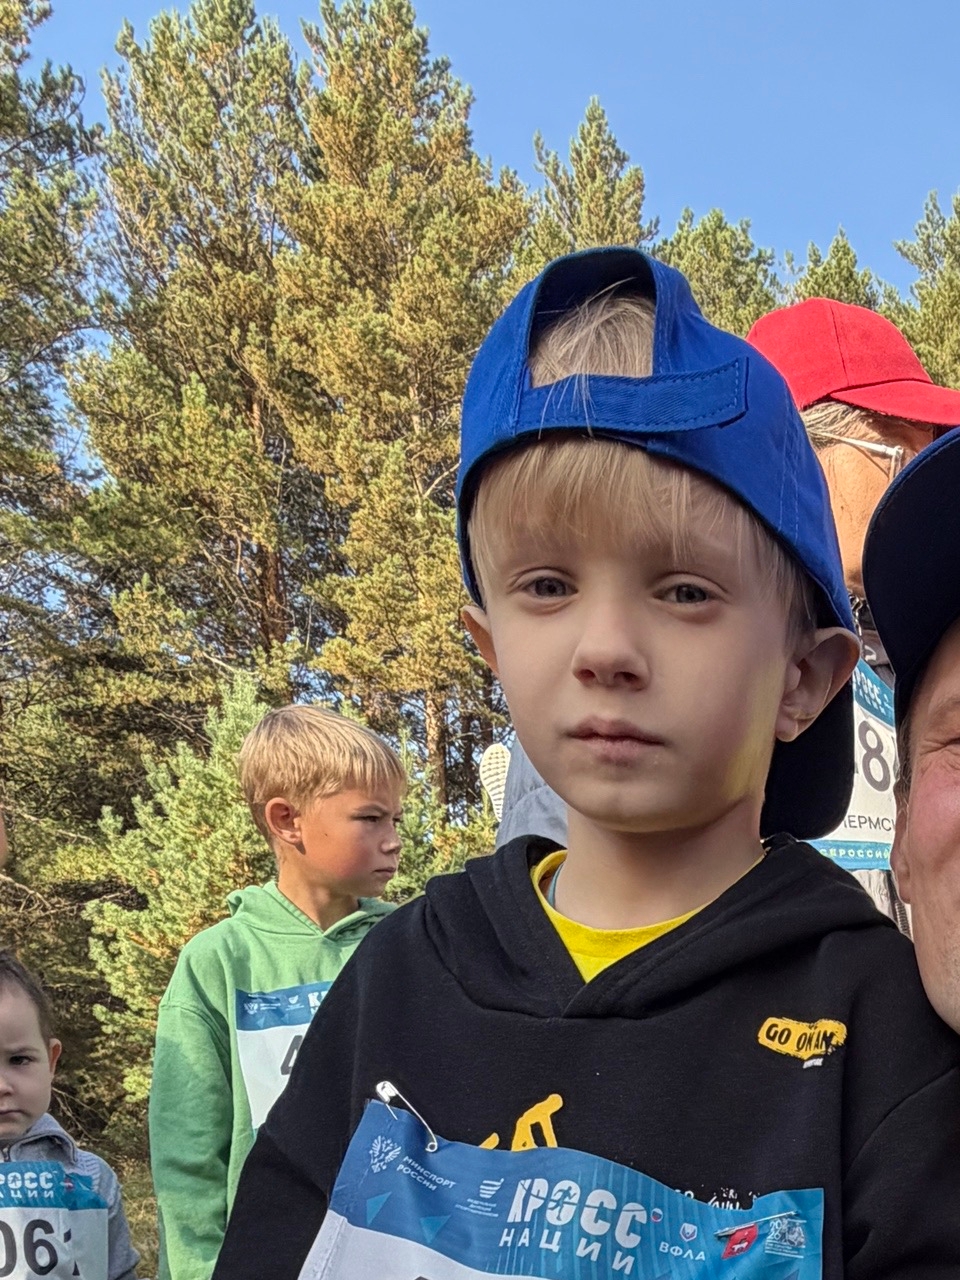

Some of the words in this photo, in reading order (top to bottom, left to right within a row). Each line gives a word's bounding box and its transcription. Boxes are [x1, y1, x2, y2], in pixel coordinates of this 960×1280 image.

[766, 1023, 792, 1045] GO
[396, 1163, 437, 1191] РОССИИ
[403, 1155, 457, 1189] МИНСПОРТ
[506, 1177, 648, 1249] КРОСС
[499, 1227, 636, 1276] НАЦИИ
[659, 1240, 707, 1262] ВФЛА
